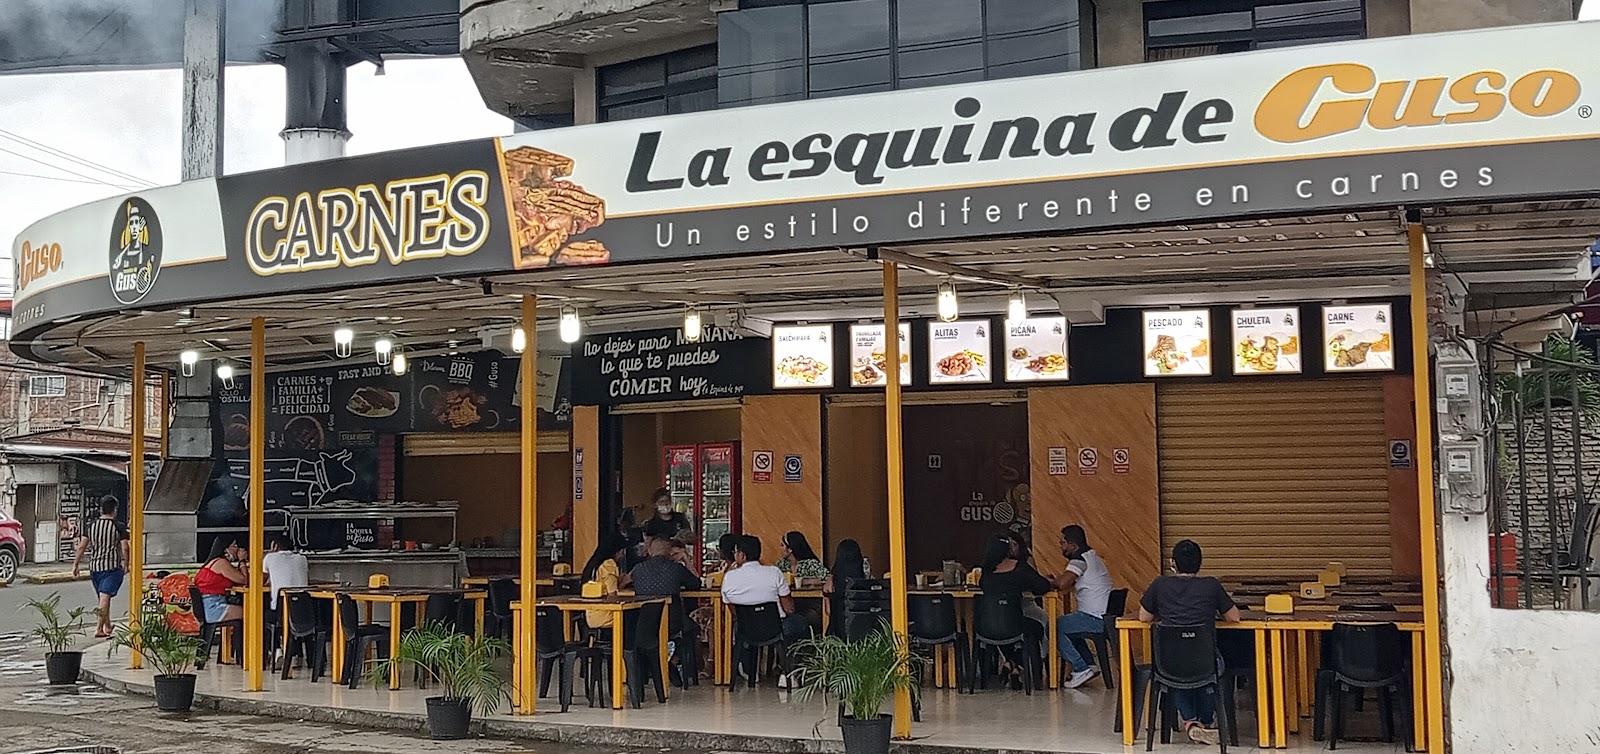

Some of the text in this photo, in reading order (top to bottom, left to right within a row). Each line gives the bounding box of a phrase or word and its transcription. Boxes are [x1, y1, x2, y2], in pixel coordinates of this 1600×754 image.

[626, 130, 734, 193] La
[748, 97, 1097, 186] esquina
[1108, 90, 1234, 151] de
[1254, 62, 1582, 144] Guso
[656, 165, 1494, 248] Un estilo diferente en carnes
[245, 169, 491, 277] CARNES
[20, 240, 62, 291] Guso
[1148, 318, 1183, 328] PESCADO
[1236, 316, 1271, 326] CHULETA
[1327, 312, 1355, 322] CARNE
[934, 328, 959, 337] ALITAS
[583, 341, 601, 357] No
[604, 336, 636, 359] dejes
[638, 335, 672, 355] para
[449, 361, 474, 381] BBQ
[600, 346, 720, 379] lo que te puedes
[277, 375, 317, 387] CARNES
[338, 369, 360, 380] FAST
[361, 366, 381, 378] AND
[488, 361, 499, 389] #Guso
[609, 375, 708, 398] COMER hoy
[279, 394, 323, 406] DELICIAS
[280, 404, 330, 415] FELICIDAD
